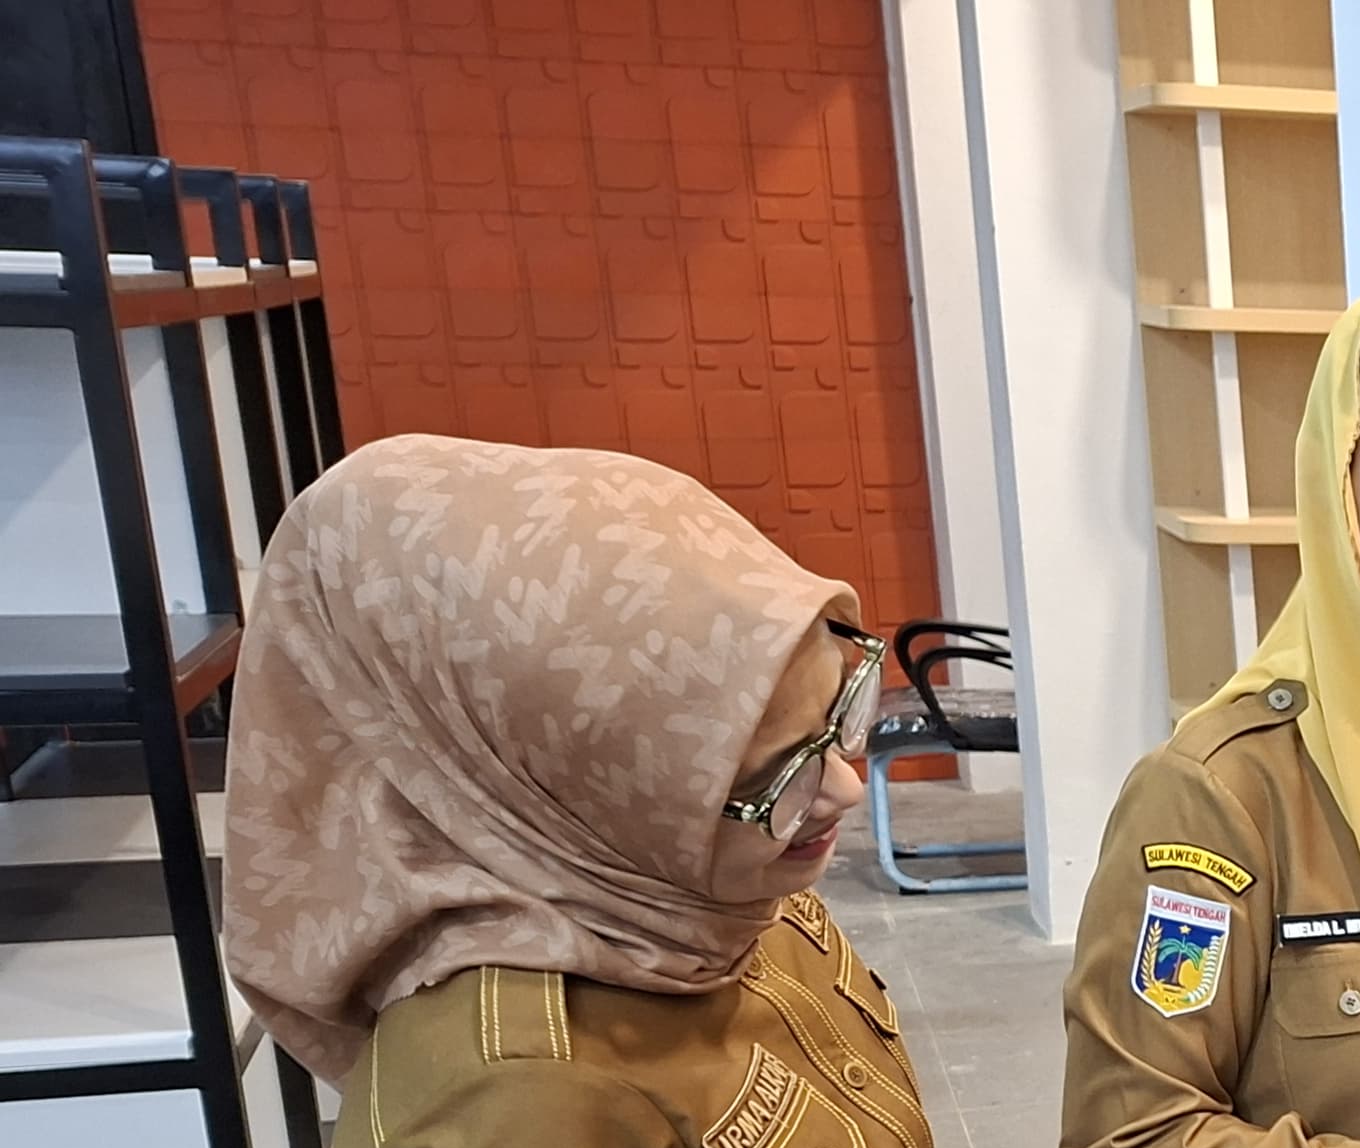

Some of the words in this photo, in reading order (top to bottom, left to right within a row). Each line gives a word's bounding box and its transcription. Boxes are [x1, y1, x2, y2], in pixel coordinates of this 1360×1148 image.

[1148, 847, 1202, 865] SULAWESI
[1205, 857, 1246, 889] TENGAH
[1151, 895, 1192, 917] SULAWESI
[1192, 905, 1227, 923] TENGAH
